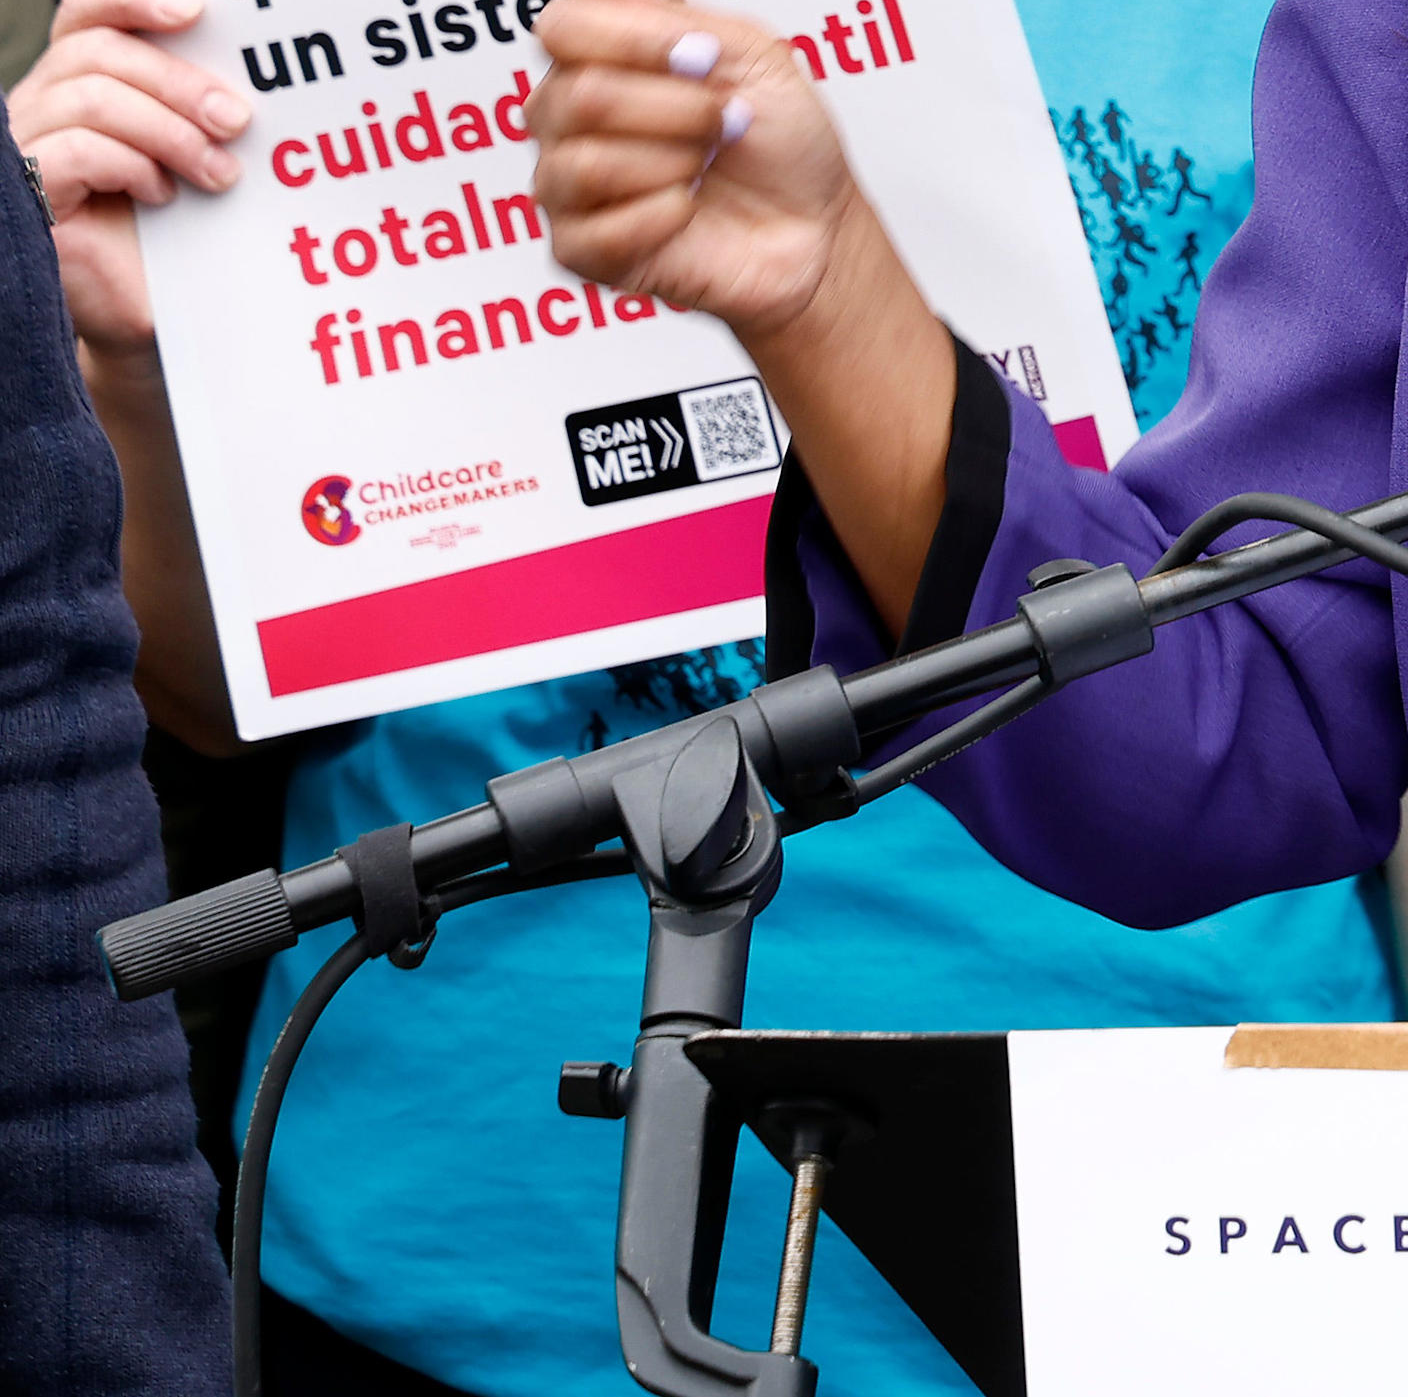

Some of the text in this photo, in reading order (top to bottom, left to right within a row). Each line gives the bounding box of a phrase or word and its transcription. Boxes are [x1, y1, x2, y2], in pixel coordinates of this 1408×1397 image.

[240, 31, 345, 93] un
[271, 69, 532, 188] cuidad
[309, 281, 692, 386] financia
[577, 416, 648, 452] SCAN
[358, 459, 503, 505] Childcare
[583, 442, 656, 491] ME!
[364, 476, 541, 526] CHANGEMAKERS
